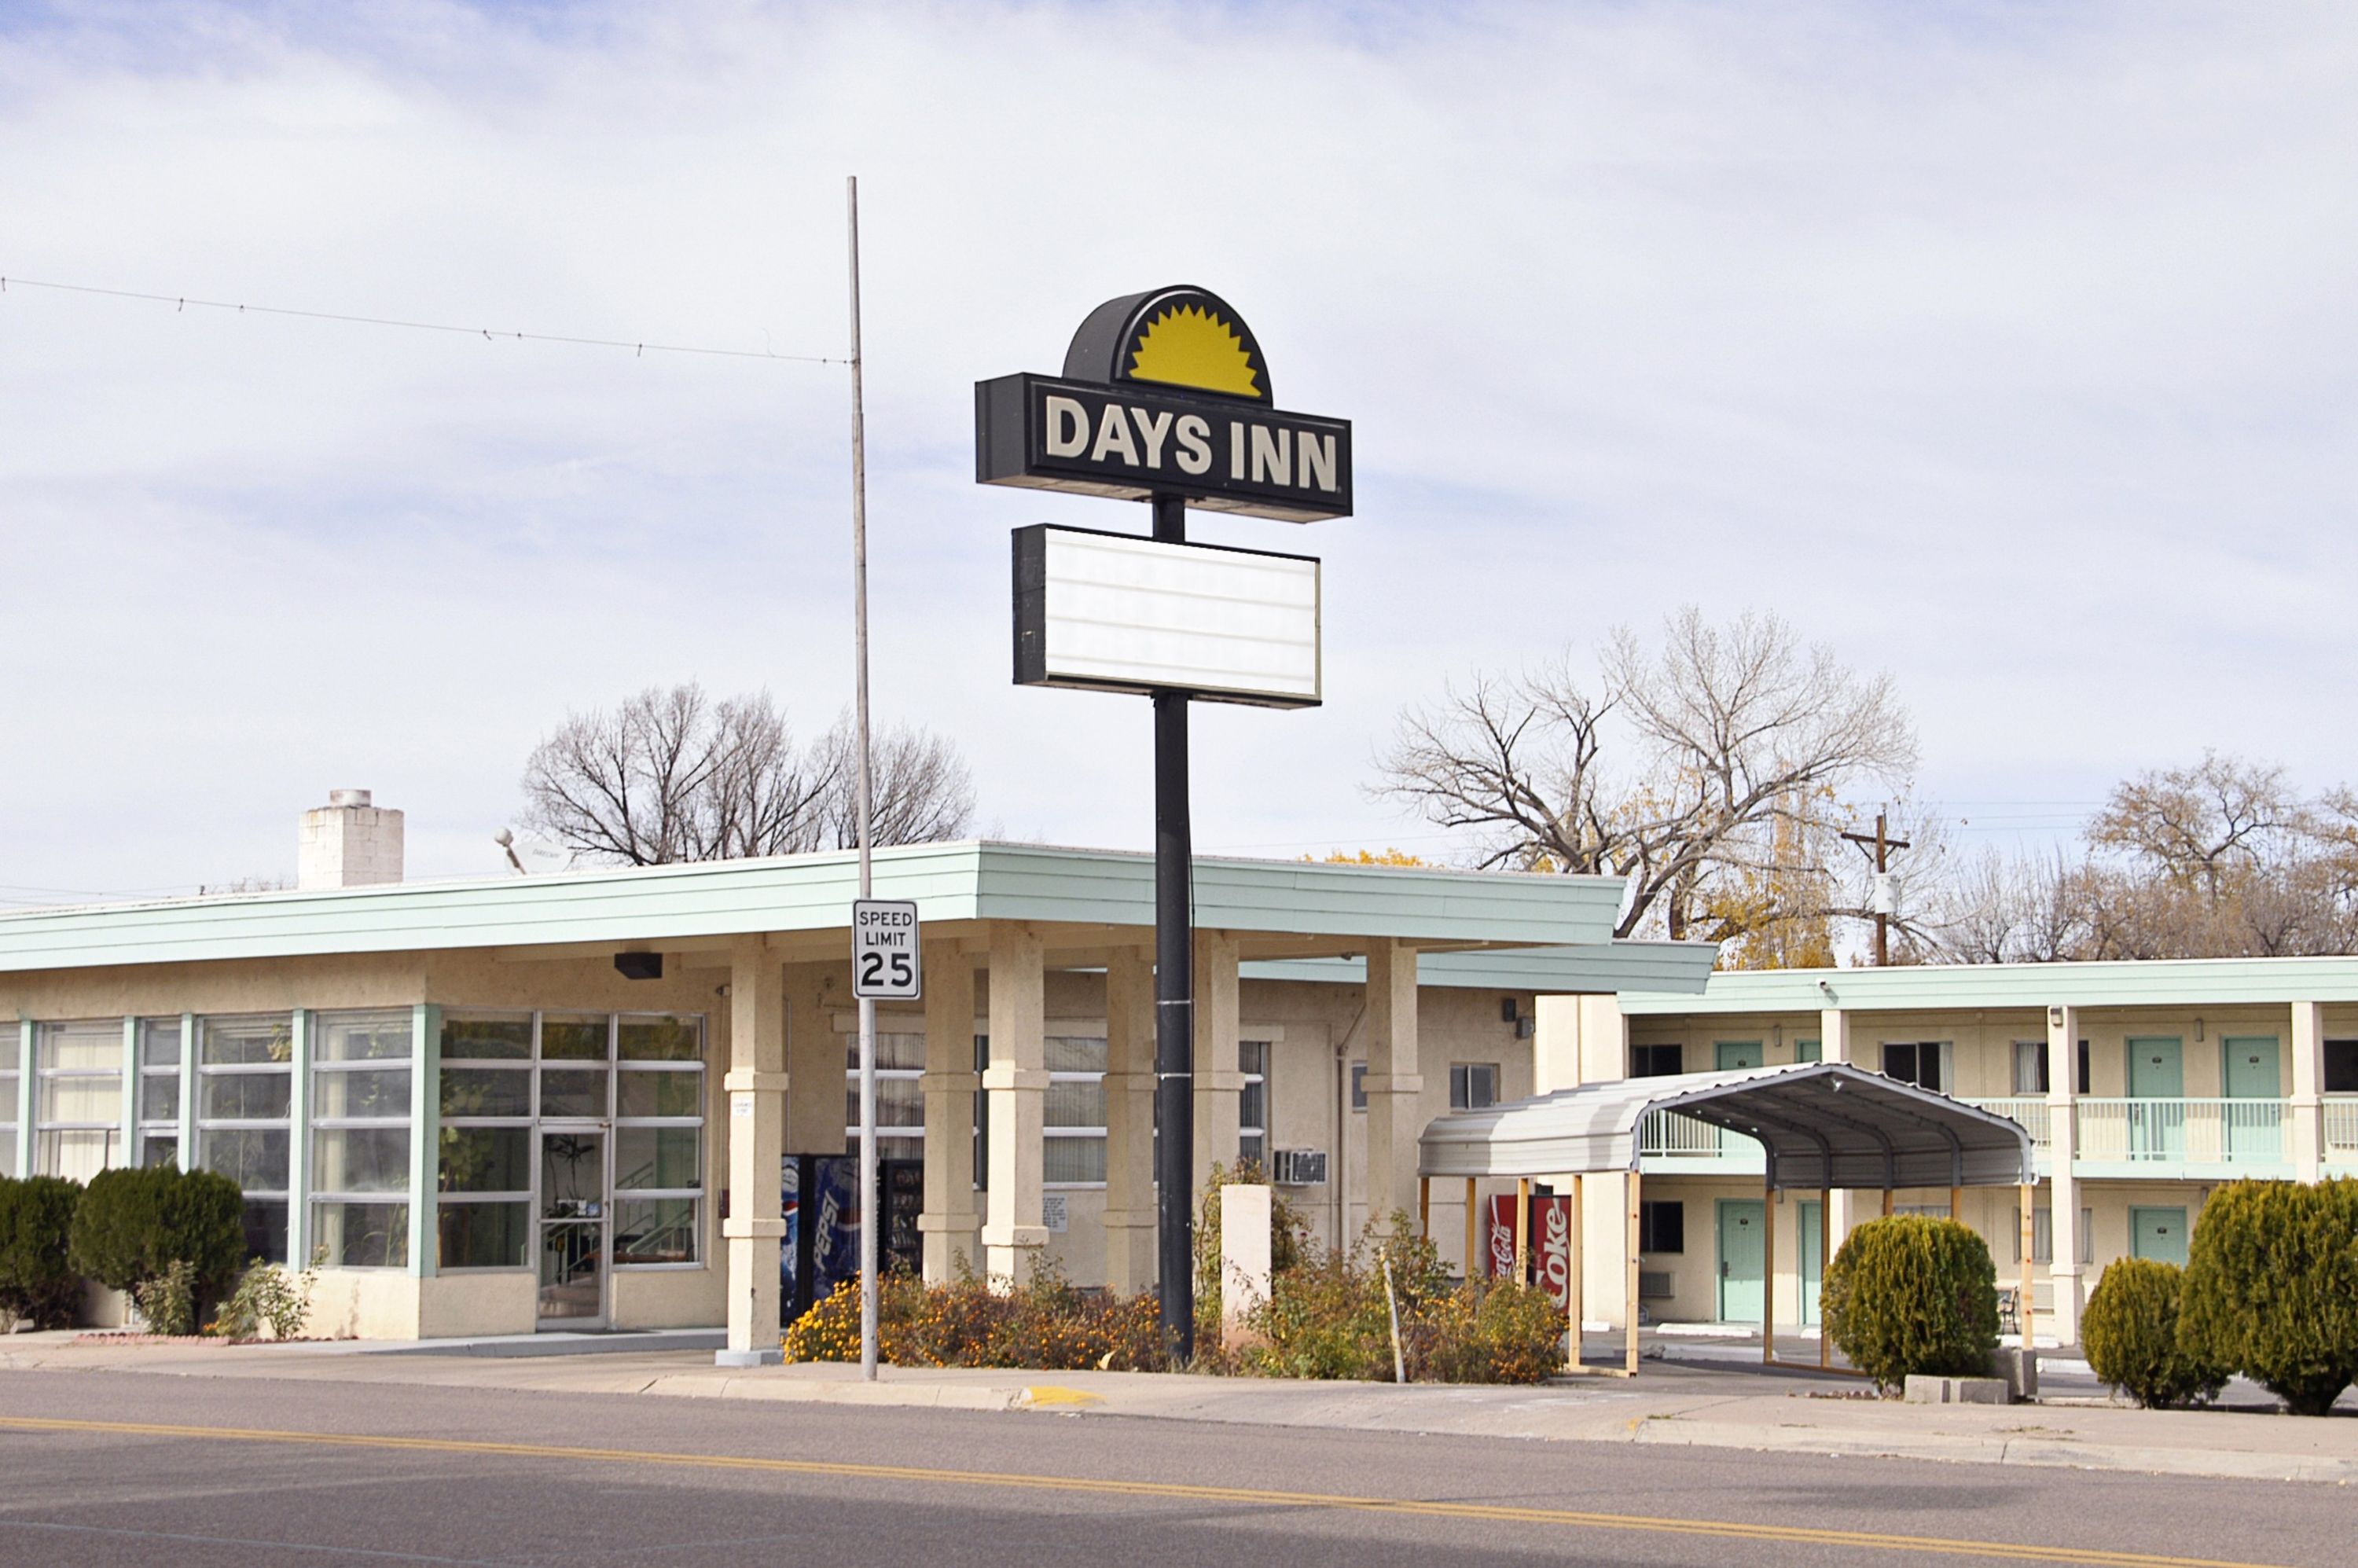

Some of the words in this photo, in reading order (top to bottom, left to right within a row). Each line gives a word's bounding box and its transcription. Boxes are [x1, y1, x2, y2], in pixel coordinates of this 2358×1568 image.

[1046, 395, 1212, 475] DAYS
[1231, 422, 1336, 492] INN
[859, 912, 913, 927] SPEED
[865, 931, 906, 946] LIMIT
[861, 952, 913, 987] 25
[813, 1188, 839, 1272] PEPSI
[1536, 1206, 1568, 1309] Coke
